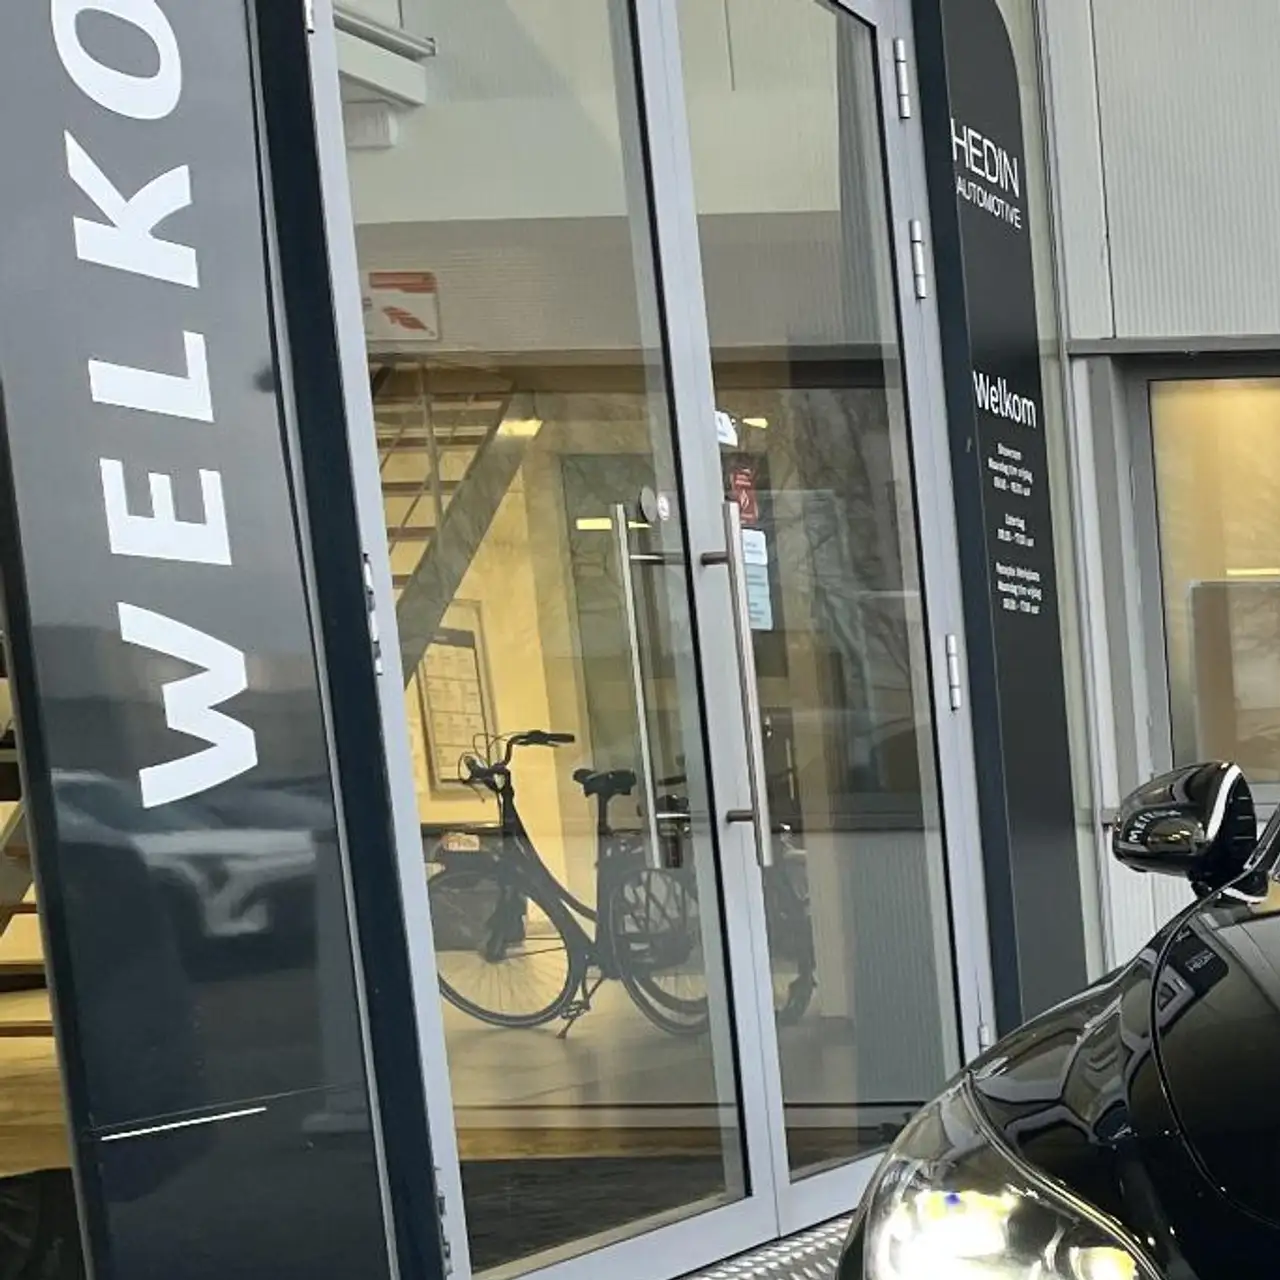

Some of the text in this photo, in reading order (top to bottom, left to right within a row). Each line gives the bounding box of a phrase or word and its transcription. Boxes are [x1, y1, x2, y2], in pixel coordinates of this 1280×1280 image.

[950, 118, 1020, 198] HEDIN
[956, 176, 1022, 230] AUTOMOTIVE
[973, 370, 1037, 429] Welkom
